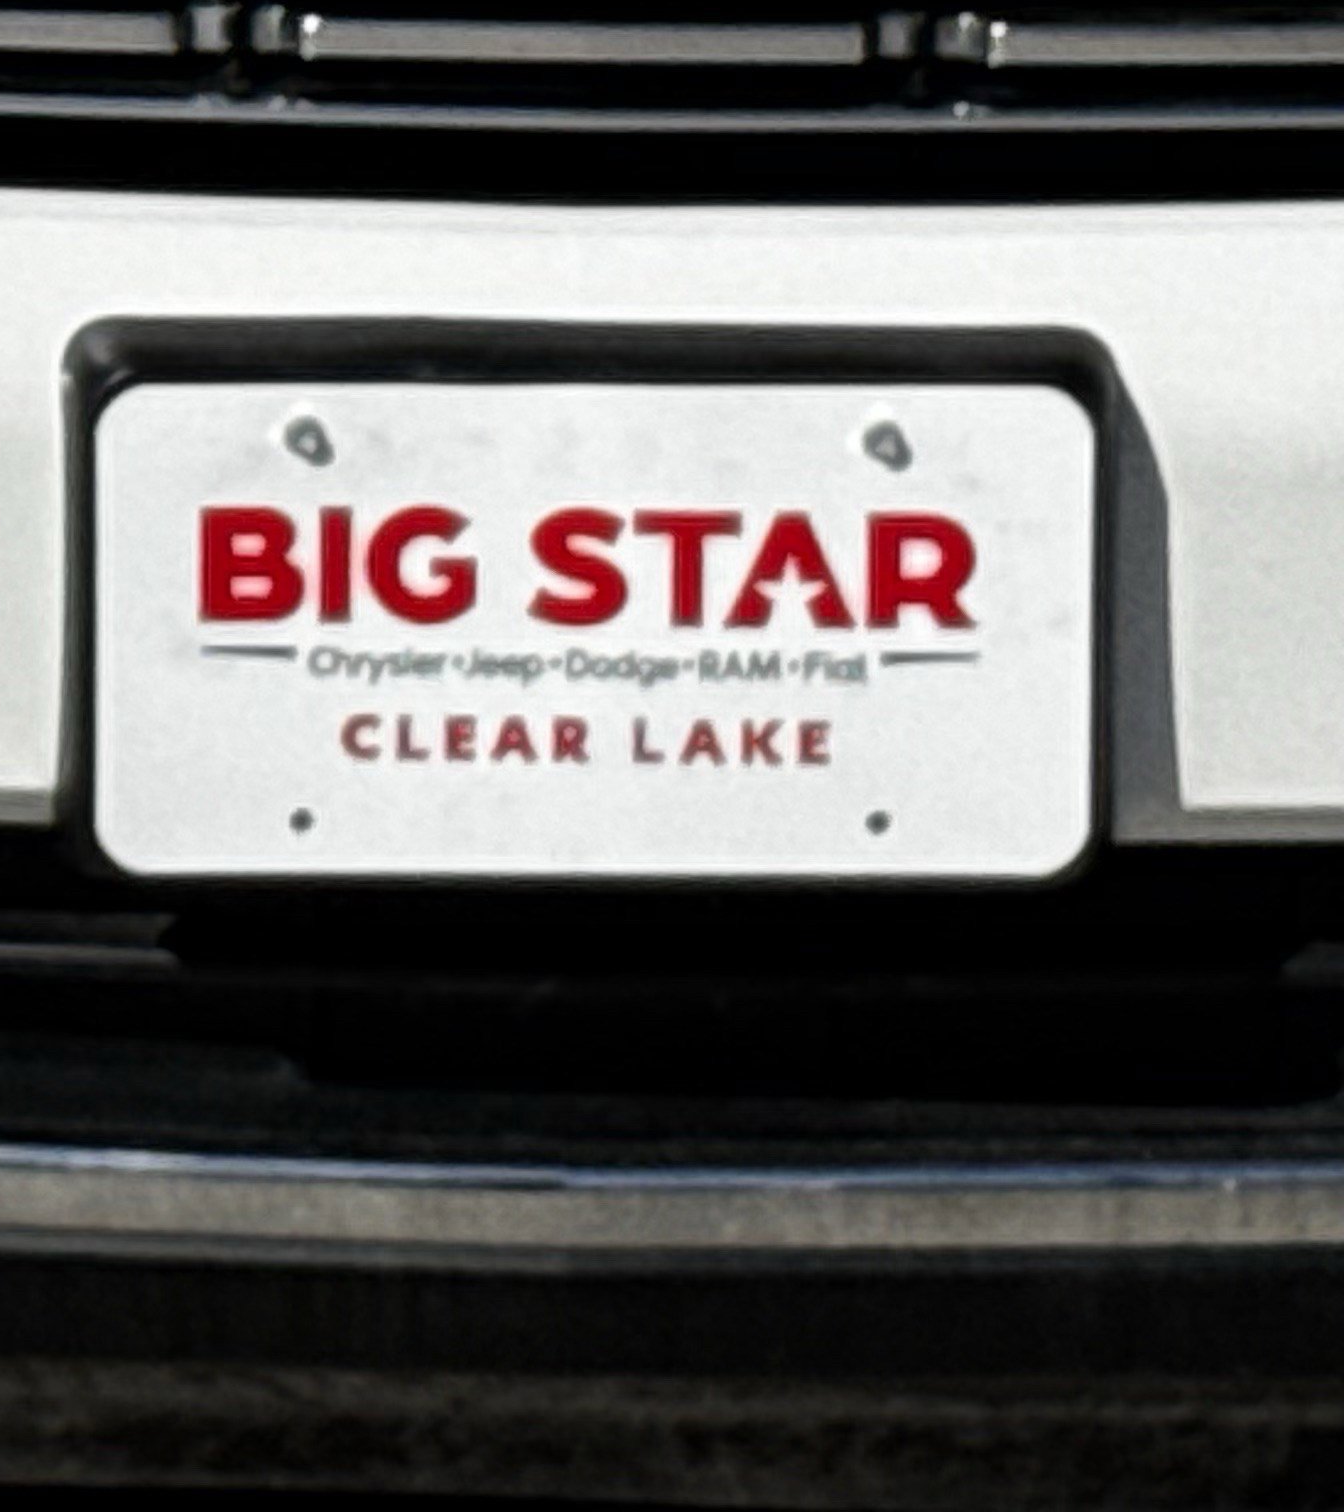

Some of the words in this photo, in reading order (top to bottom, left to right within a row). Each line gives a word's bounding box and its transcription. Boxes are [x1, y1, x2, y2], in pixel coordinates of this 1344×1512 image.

[198, 505, 477, 626] BIG
[528, 507, 977, 630] STAR
[340, 713, 590, 765] CLEAR
[632, 717, 831, 767] LAKE
